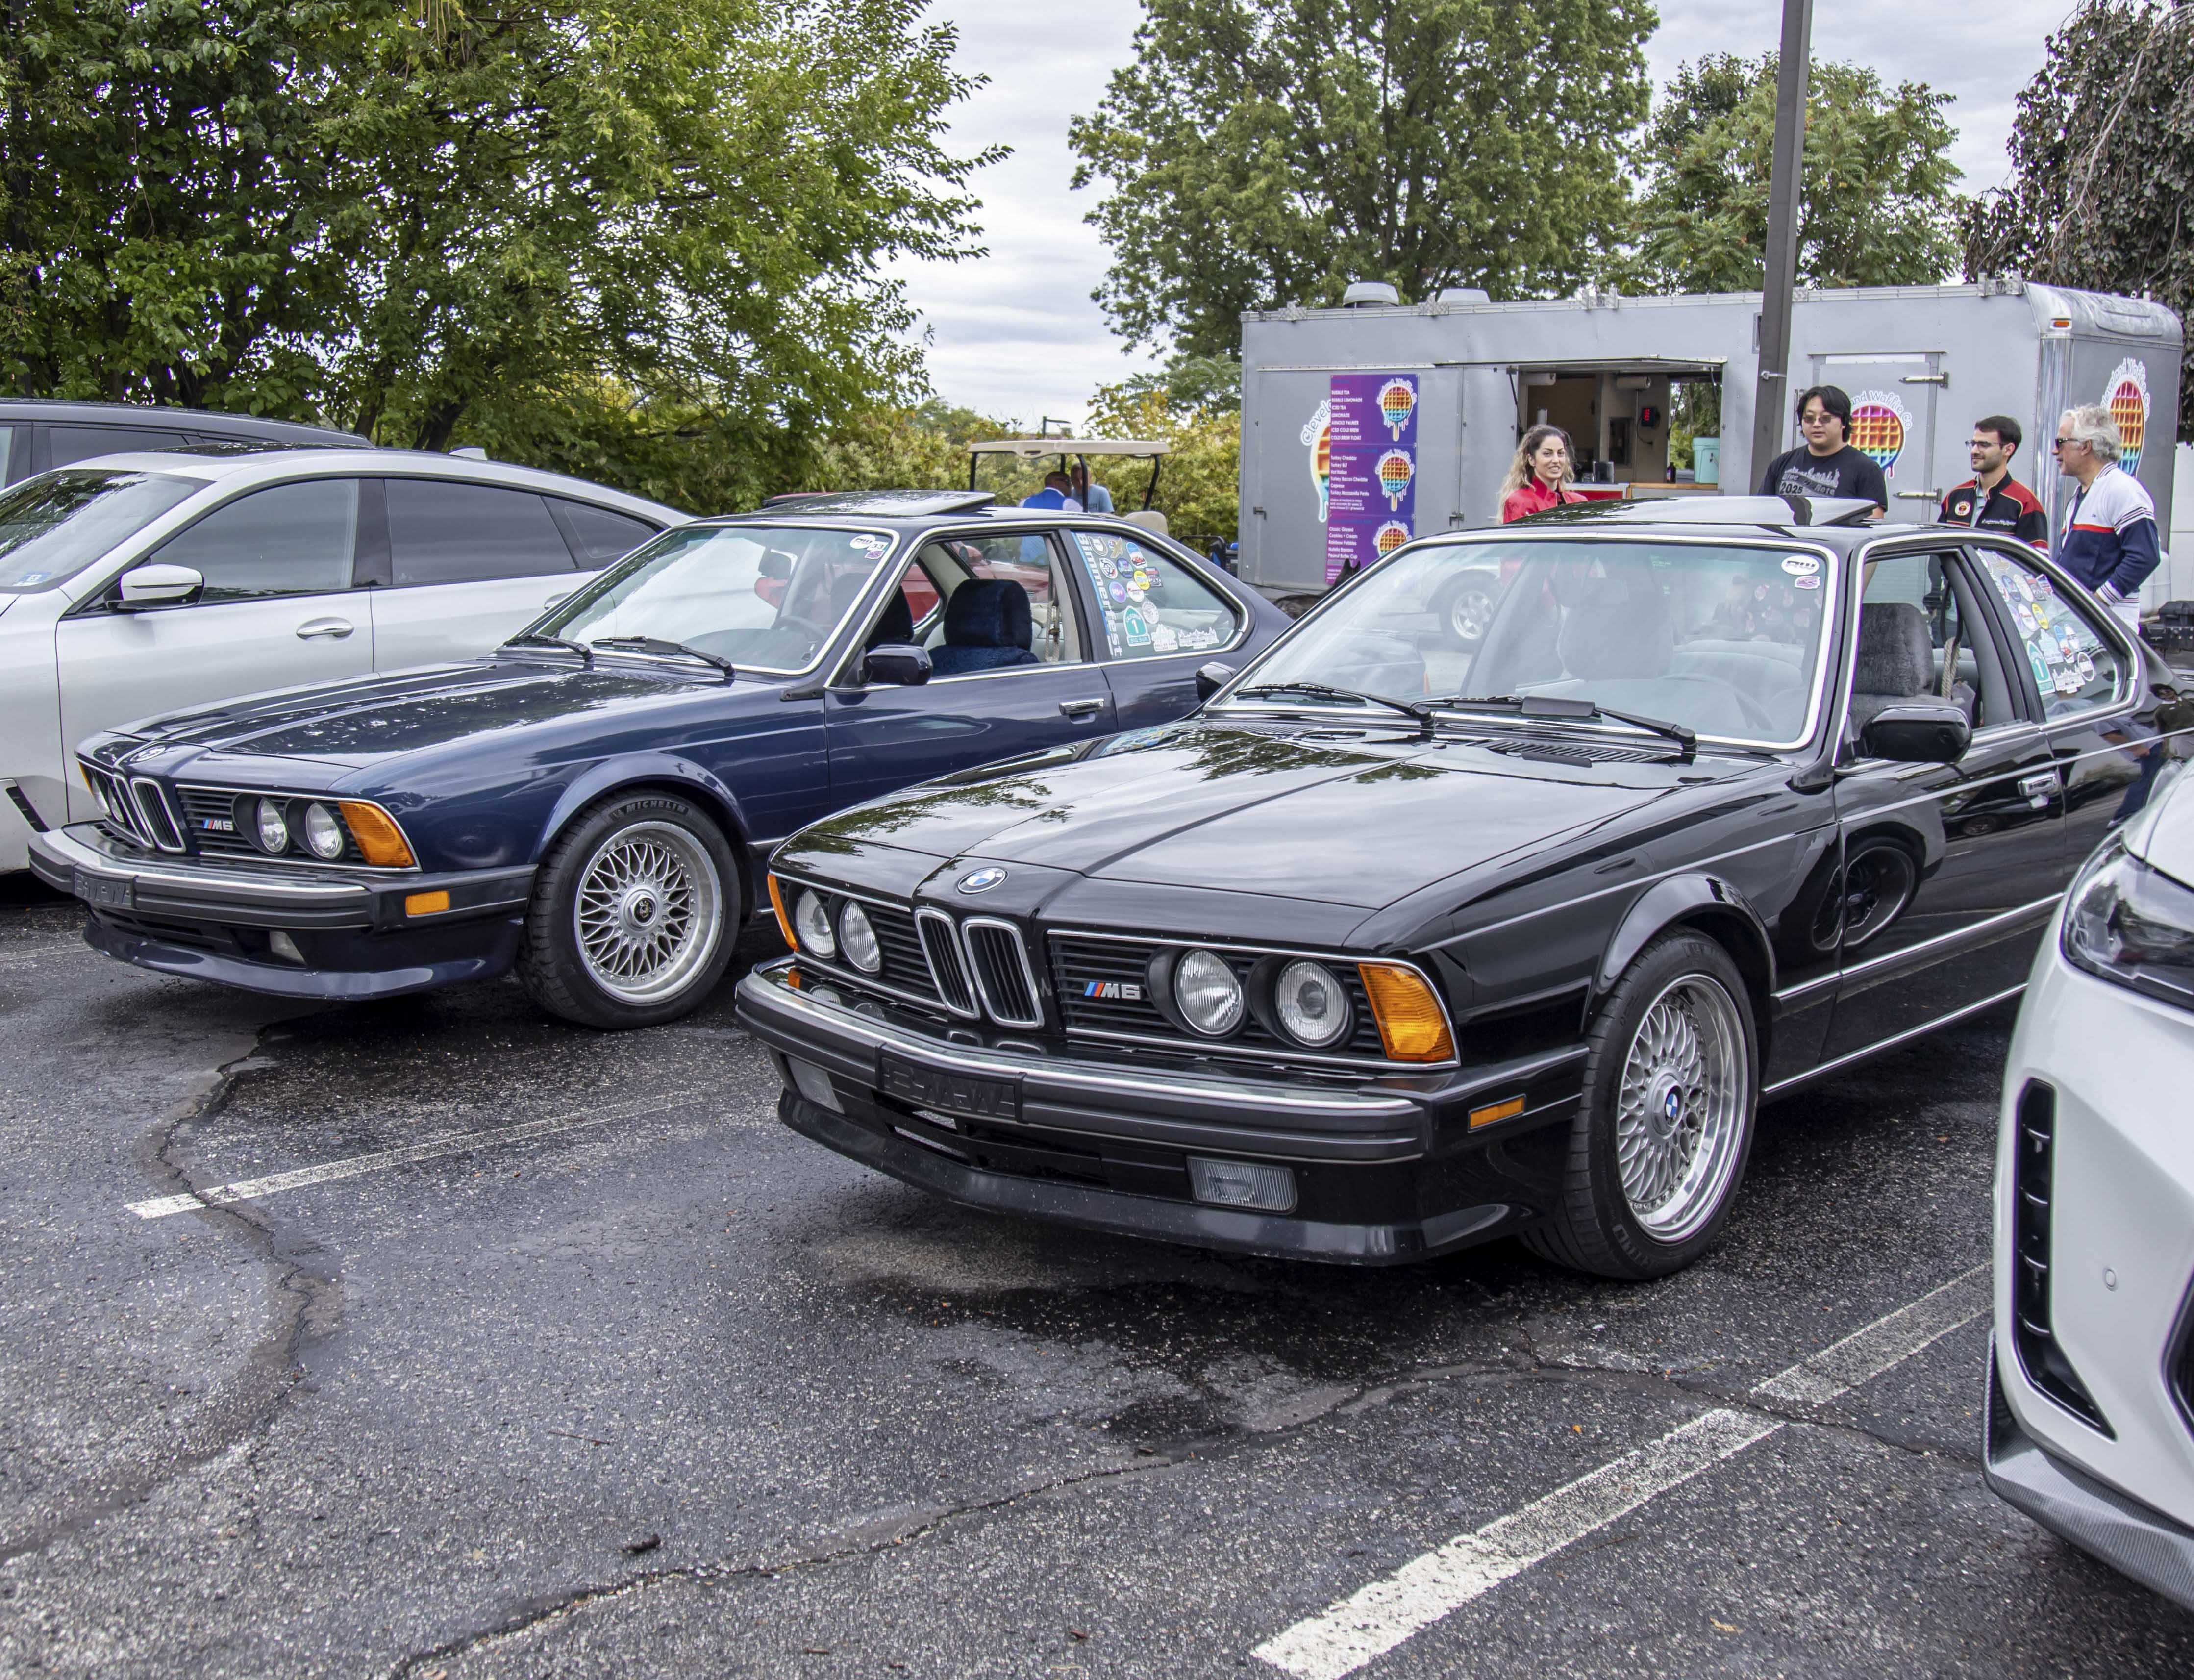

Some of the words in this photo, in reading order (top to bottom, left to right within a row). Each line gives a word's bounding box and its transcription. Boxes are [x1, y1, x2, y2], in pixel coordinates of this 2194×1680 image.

[1869, 390, 1904, 413] Waffle
[1301, 399, 1331, 445] Clevel
[1780, 482, 1803, 494] 2025
[1131, 619, 1139, 634] 1
[2035, 658, 2044, 678] 1
[626, 800, 686, 813] MICHELIN
[212, 819, 234, 831] M6
[1100, 983, 1141, 1000] M6
